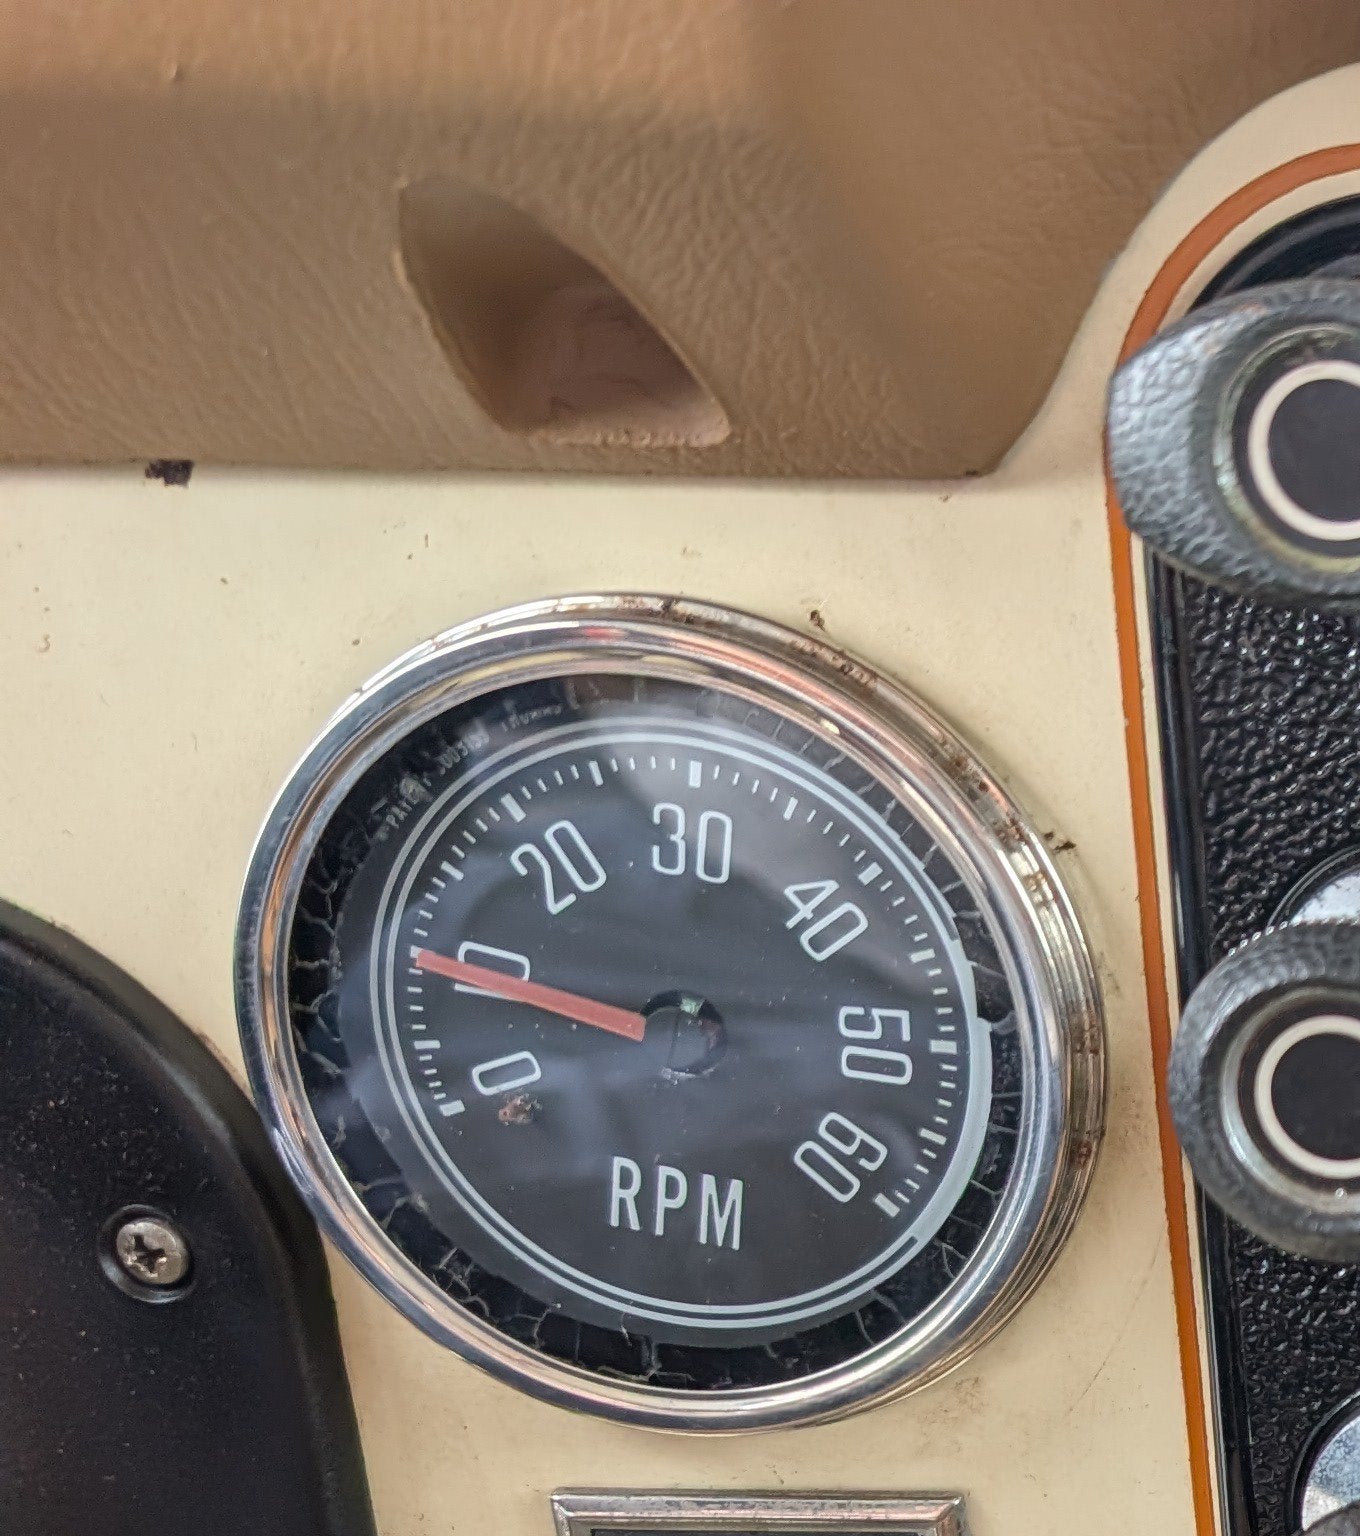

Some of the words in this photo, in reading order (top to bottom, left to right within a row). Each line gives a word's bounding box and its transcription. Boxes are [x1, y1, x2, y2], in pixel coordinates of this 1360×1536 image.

[512, 820, 606, 914] 20
[651, 802, 732, 883] 30
[783, 879, 868, 961] 40
[471, 1050, 542, 1096] 0
[838, 1006, 911, 1085] 50
[794, 1112, 887, 1203] 60
[609, 1157, 743, 1251] RPM
